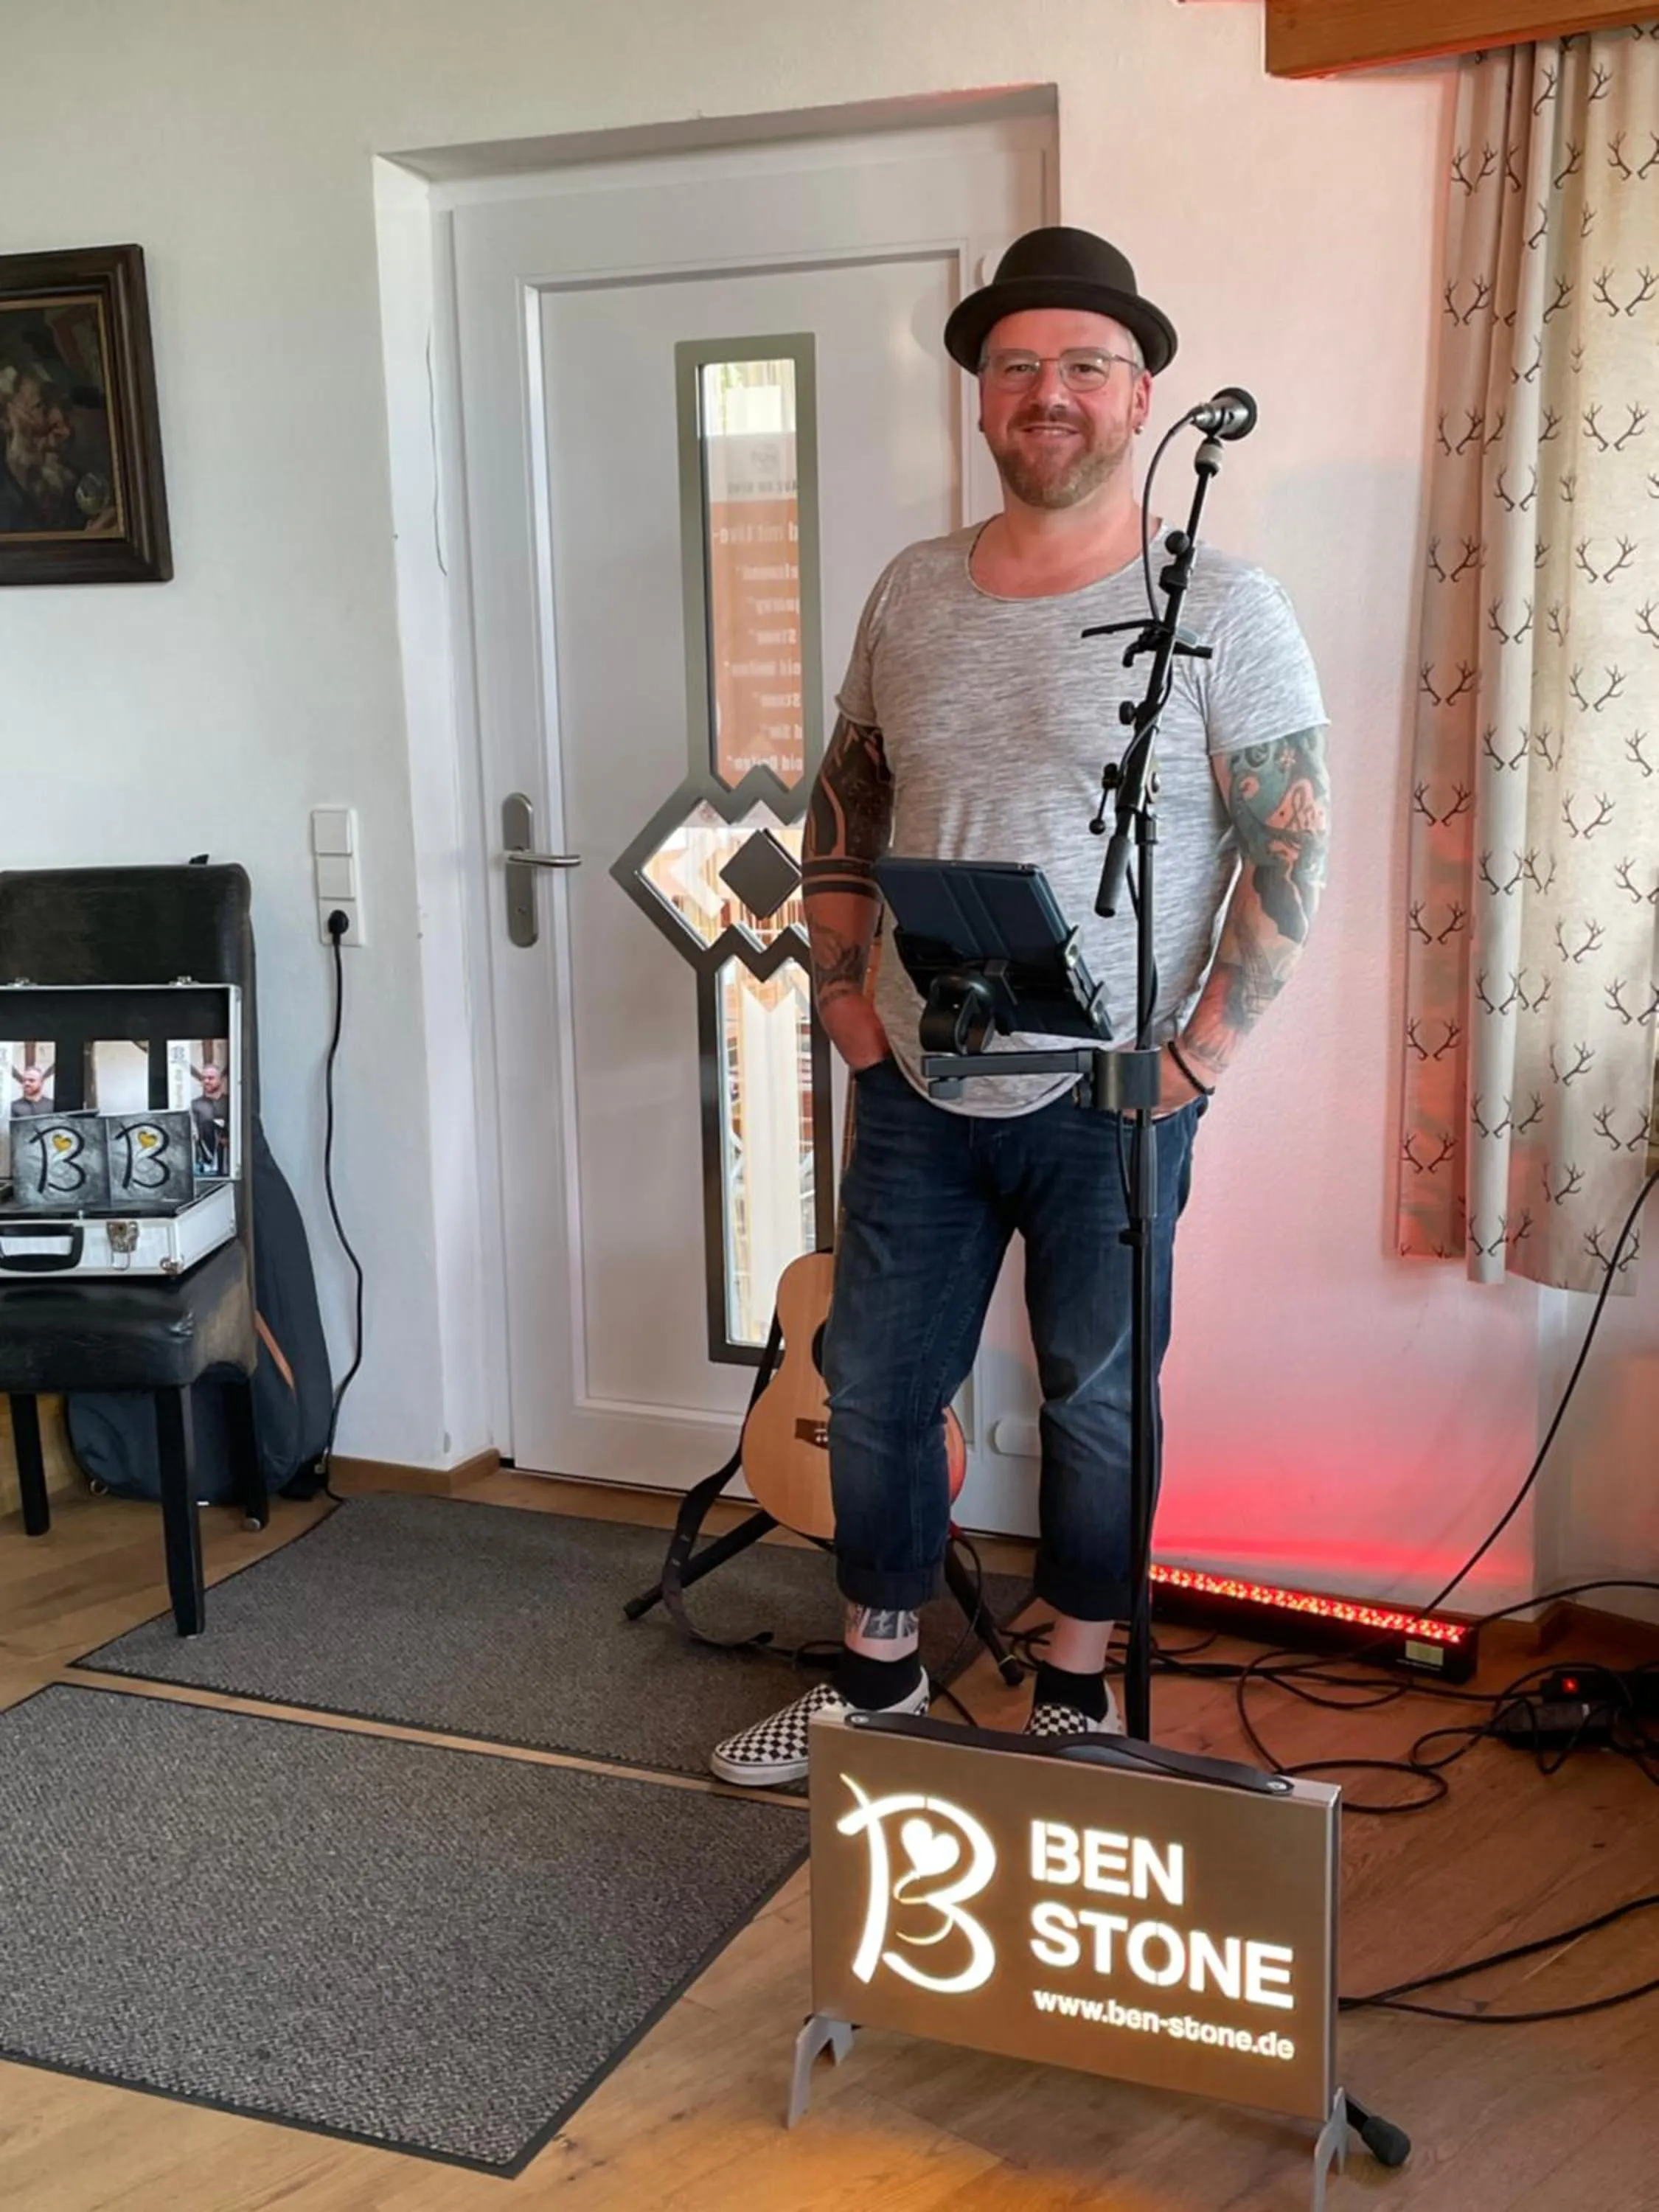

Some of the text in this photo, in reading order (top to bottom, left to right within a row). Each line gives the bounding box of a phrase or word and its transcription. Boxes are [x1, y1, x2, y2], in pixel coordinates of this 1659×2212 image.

[1030, 1819, 1184, 1905] BEN
[1029, 1900, 1295, 2010] STONE
[1032, 1987, 1295, 2060] www.ben-stone.de
